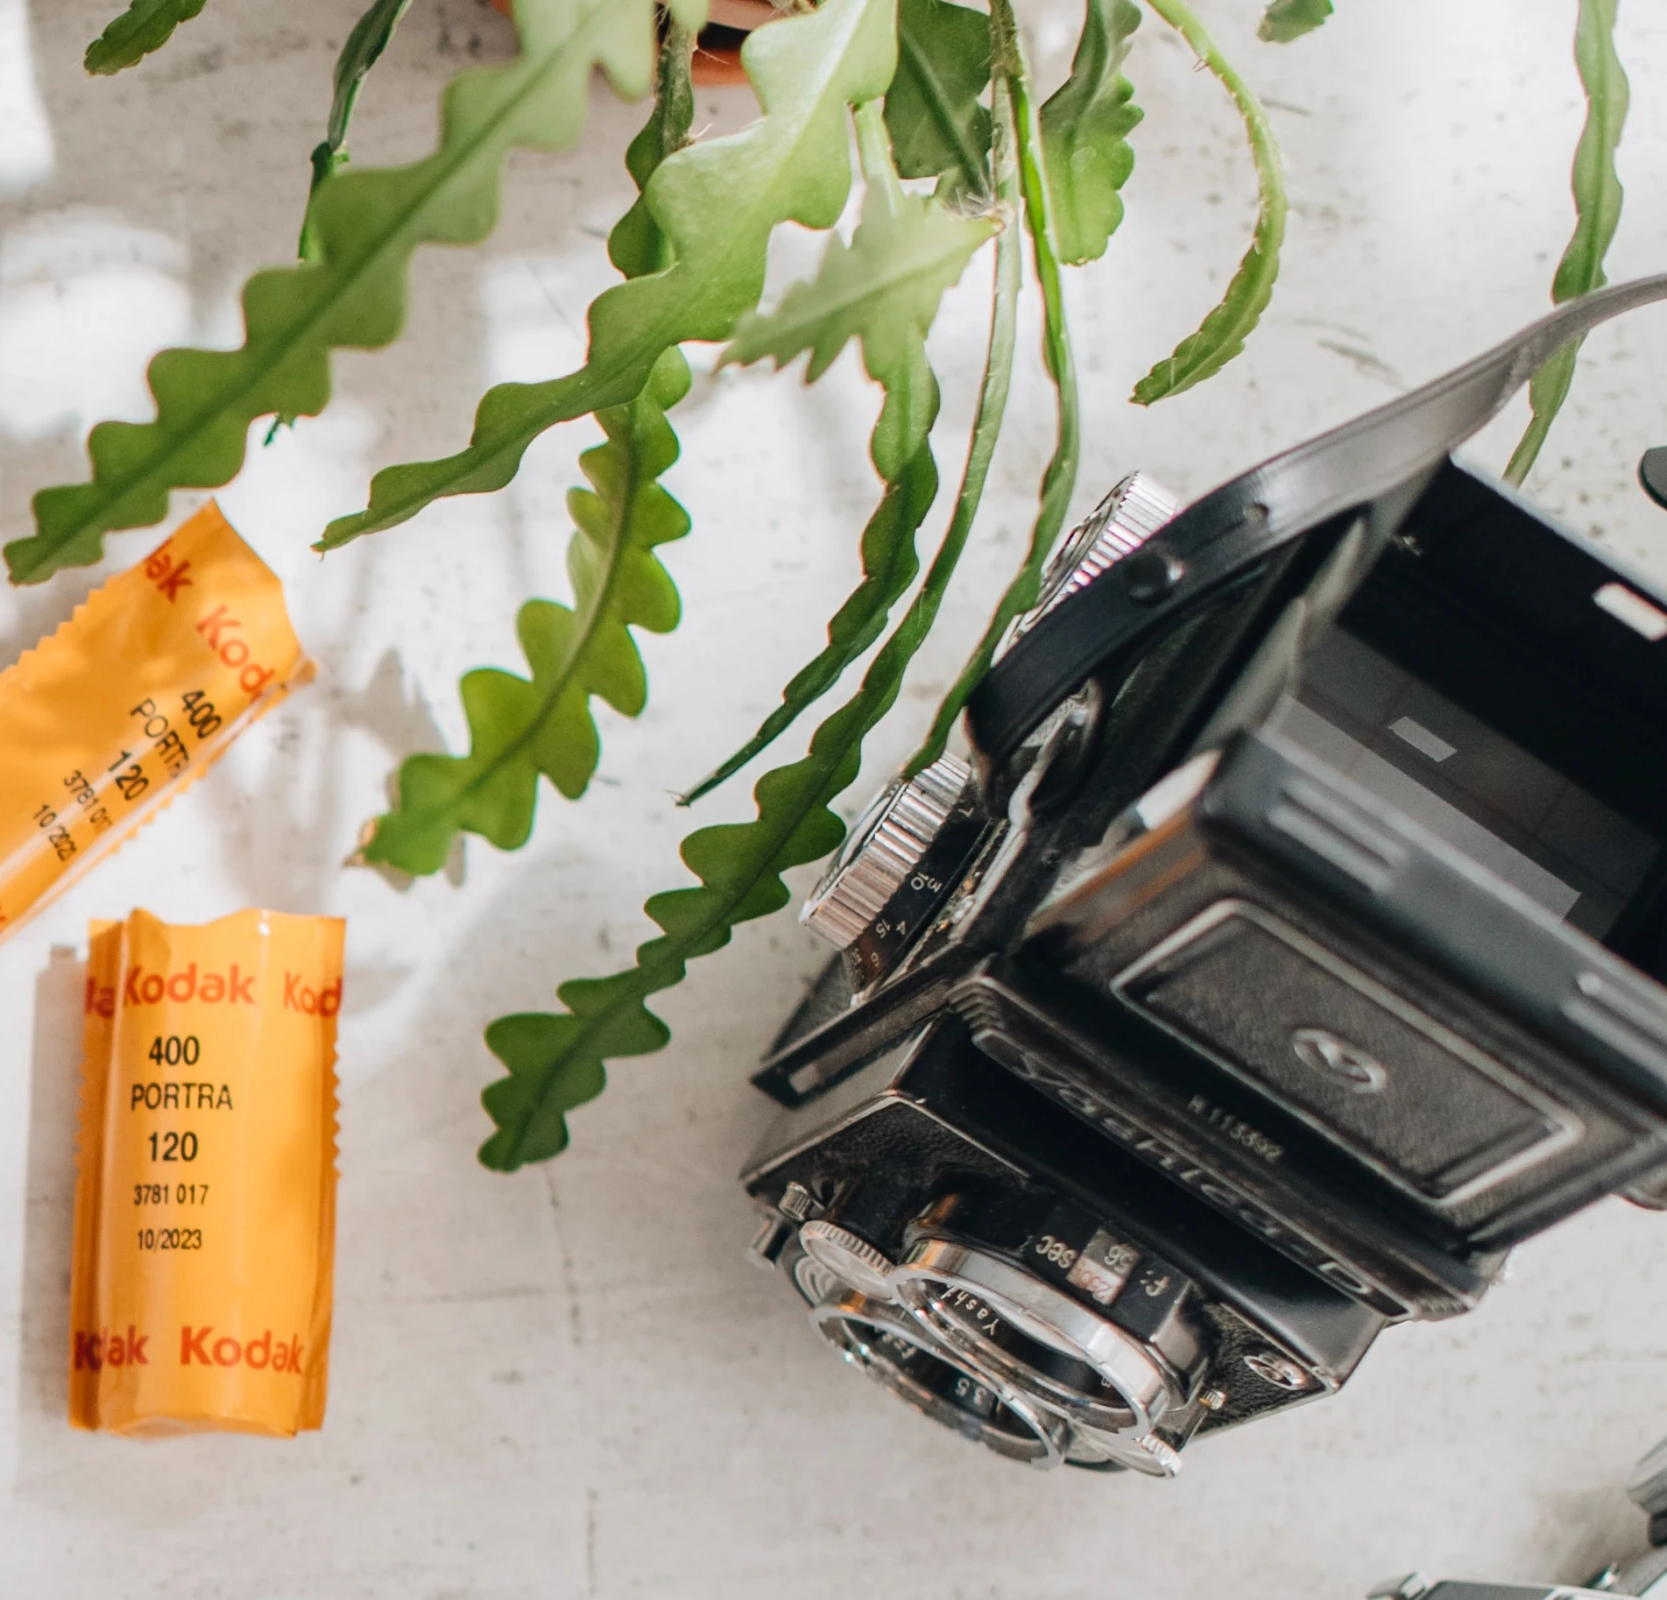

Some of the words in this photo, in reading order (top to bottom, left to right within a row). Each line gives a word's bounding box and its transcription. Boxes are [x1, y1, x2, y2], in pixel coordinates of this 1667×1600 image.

[181, 690, 221, 739] 400
[64, 770, 99, 811] 3781
[108, 750, 149, 801] 120
[875, 918, 892, 939] 15
[124, 962, 256, 1008] Kodak
[148, 1036, 201, 1067] 400
[130, 1083, 234, 1111] PORTRA
[148, 1131, 198, 1162] 120
[133, 1184, 170, 1206] 3781
[176, 1184, 209, 1206] 017
[137, 1229, 203, 1251] 10/2023
[1035, 1235, 1077, 1269] sec
[180, 1326, 304, 1375] Kodak
